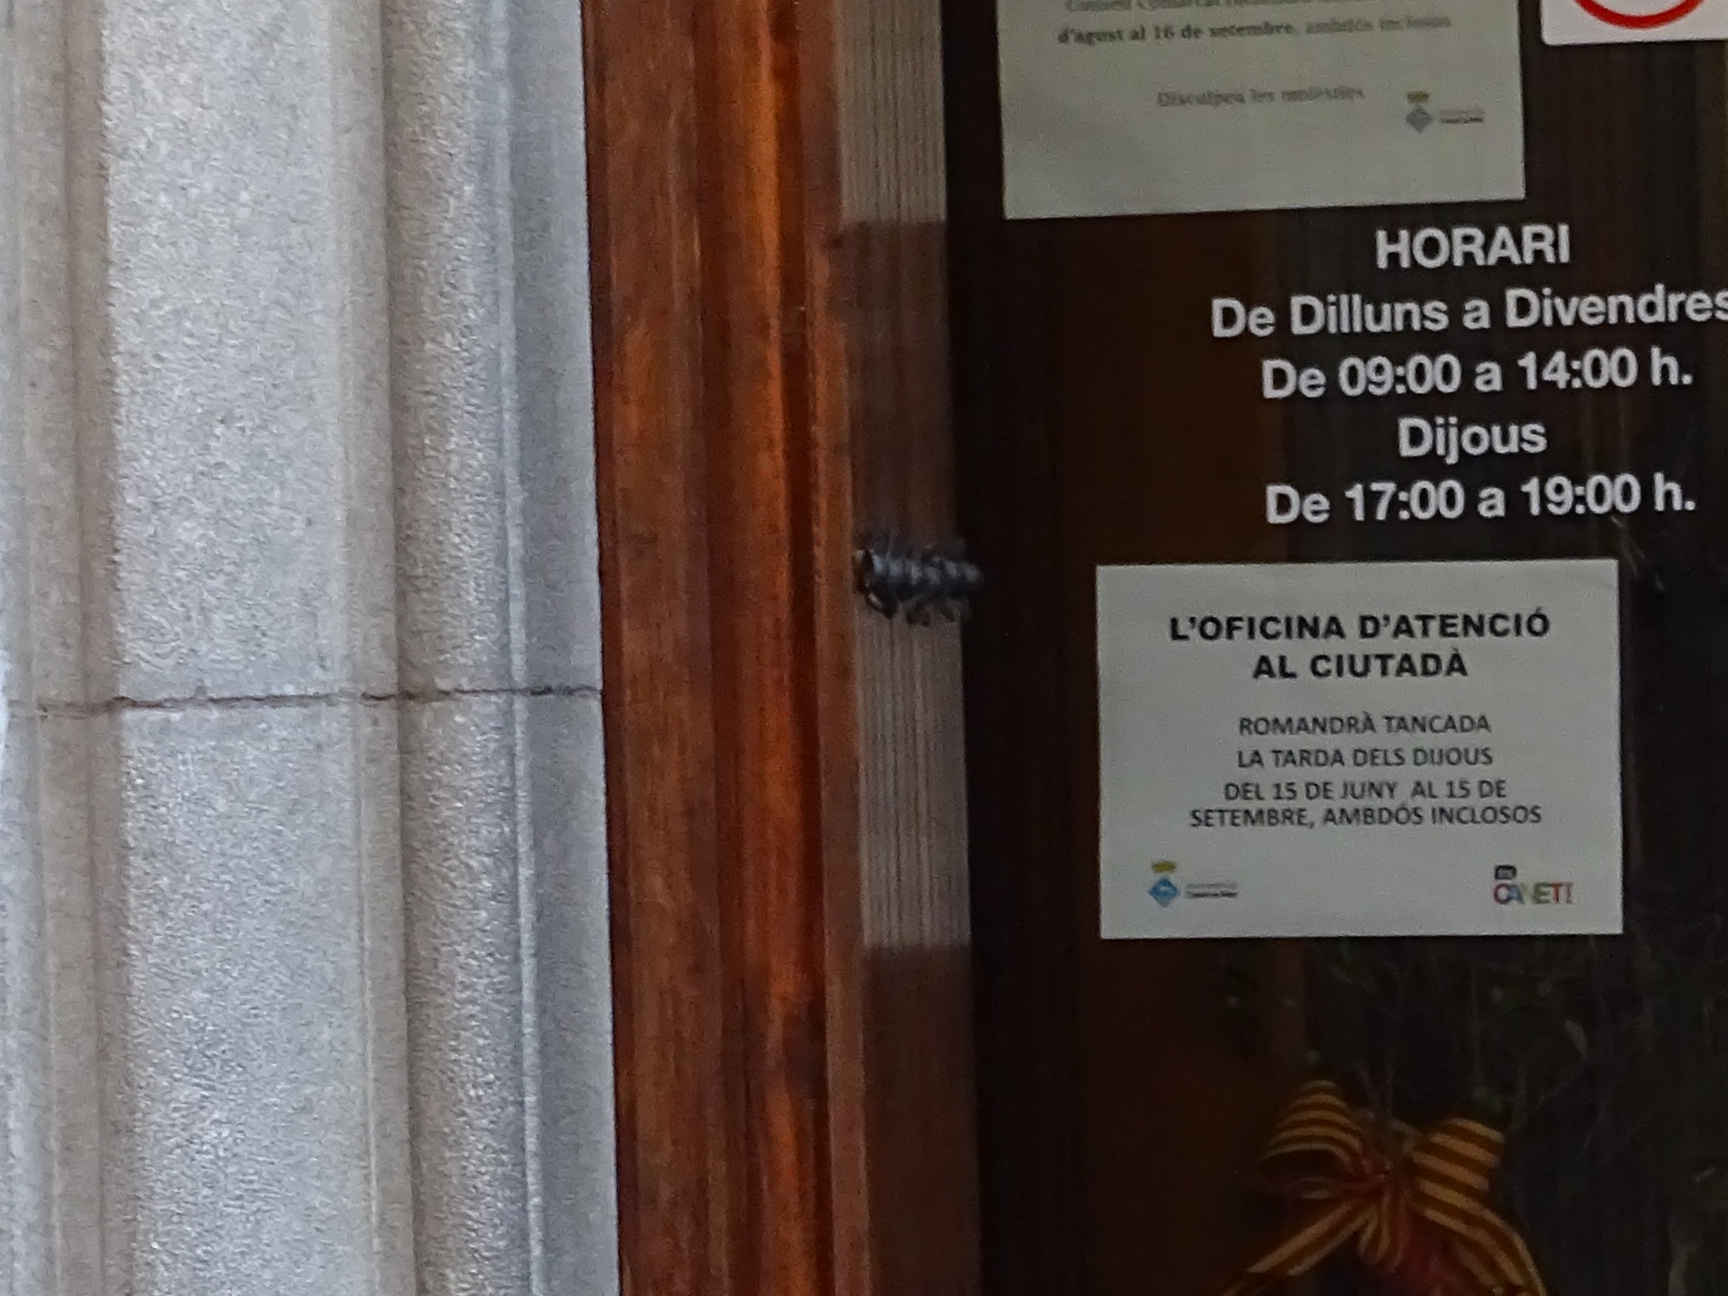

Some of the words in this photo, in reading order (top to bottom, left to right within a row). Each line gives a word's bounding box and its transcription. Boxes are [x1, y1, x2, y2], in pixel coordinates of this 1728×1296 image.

[1376, 224, 1570, 269] HORARI
[1212, 297, 1276, 338] De
[1291, 295, 1448, 334] Dilluns
[1463, 299, 1490, 330] a
[1262, 358, 1325, 399] De
[1339, 353, 1461, 397] 09:00
[1475, 359, 1501, 392] a
[1518, 348, 1637, 390] 14:00
[1651, 346, 1692, 386] h.
[1399, 416, 1546, 465] Dijous
[1266, 484, 1330, 523] De
[1345, 480, 1464, 521] 17:00
[1478, 486, 1505, 517] a
[1521, 474, 1640, 515] 19:00
[1654, 473, 1696, 511] h.
[1170, 615, 1346, 641] L'OFICINA
[1360, 608, 1550, 639] D'ATENCIÓ
[1253, 654, 1297, 679] AL
[1311, 649, 1468, 678] CIUTADÀ
[1239, 711, 1376, 736] ROMANDRÀ
[1383, 715, 1491, 734] TANCADA
[1238, 750, 1263, 768] LA
[1271, 749, 1344, 768] TARDA
[1353, 748, 1404, 767] DELS
[1413, 747, 1493, 766] DIJOUS
[1225, 782, 1265, 801] DEL
[1273, 782, 1297, 800] 15
[1306, 781, 1334, 800] DE
[1340, 781, 1396, 802] JUNY
[1411, 781, 1438, 799] AL
[1445, 780, 1470, 799] 15
[1478, 780, 1506, 798] DE
[1190, 808, 1315, 830] SETEMBRE,
[1323, 804, 1423, 825] AMBDÓS
[1432, 806, 1541, 824] INCLOSOS
